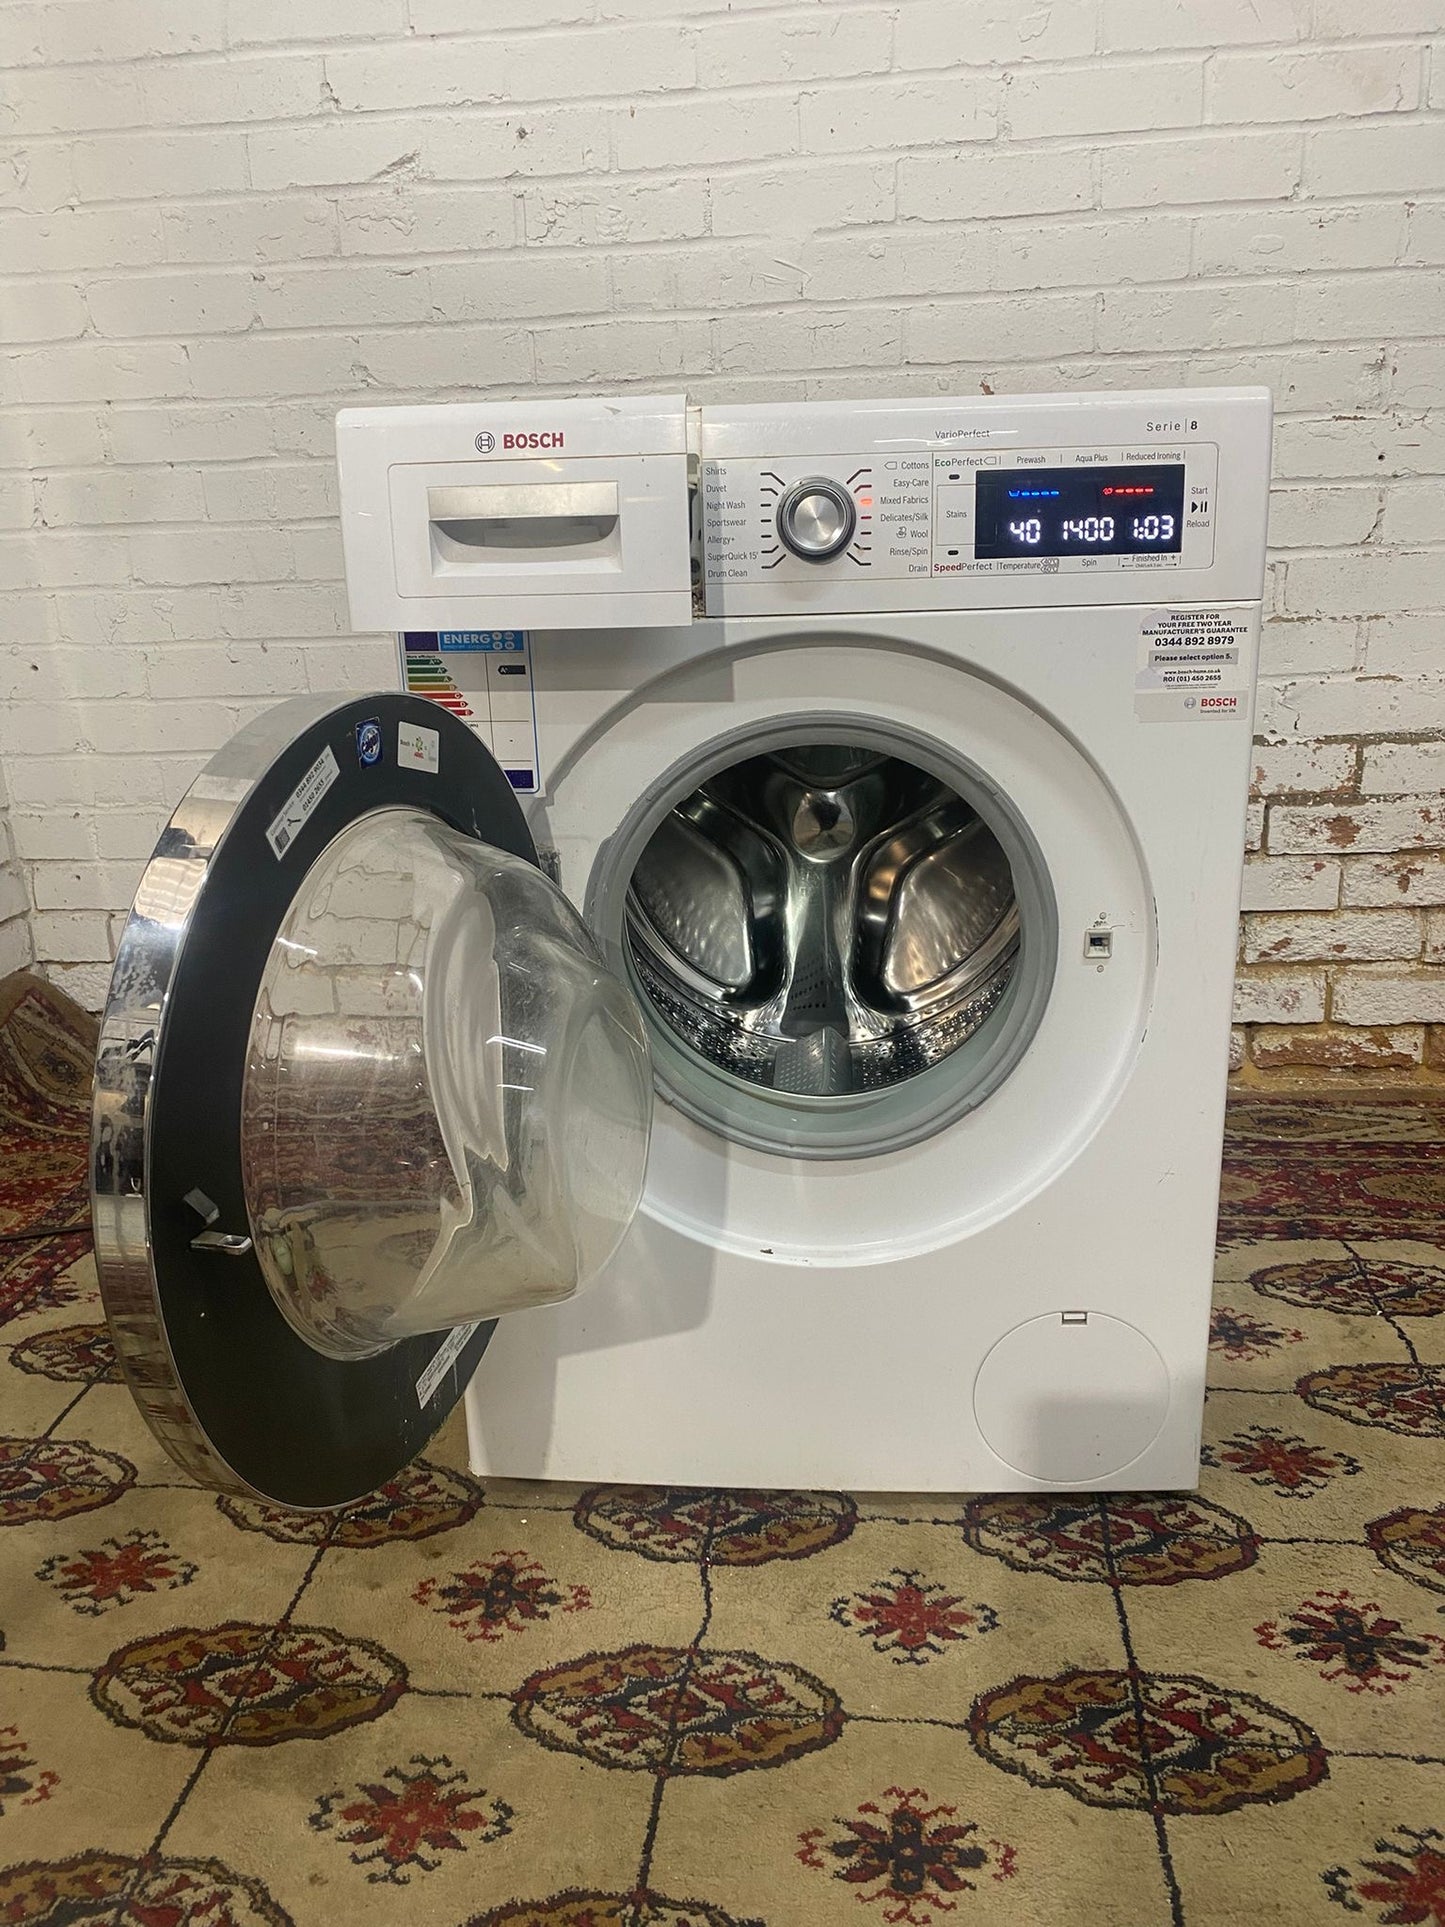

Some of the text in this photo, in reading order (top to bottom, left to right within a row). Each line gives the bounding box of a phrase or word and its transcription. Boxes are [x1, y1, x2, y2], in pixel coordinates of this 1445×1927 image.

[1146, 420, 1198, 432] Serie 8
[935, 429, 991, 440] VarioPerfect
[503, 432, 564, 449] BOSCH
[1016, 455, 1046, 464] Prewash
[1075, 453, 1108, 463] Aqua Plus
[1126, 451, 1181, 461] Reduced Ironing
[901, 461, 929, 470] Cottons
[934, 456, 984, 467] EcoPerfect
[705, 467, 727, 476] Shirts
[706, 484, 727, 493] Duvet
[893, 479, 929, 489] Easy-Care
[1190, 486, 1208, 495] Start
[880, 494, 929, 505] Mixed Fabrics
[706, 501, 746, 511] Night Wash
[880, 513, 929, 522] Delicates/Silk
[946, 511, 967, 519] Stains
[707, 519, 746, 528] Sportswear
[1133, 514, 1175, 540] 1:03
[1186, 520, 1210, 529] Reload
[1009, 518, 1041, 544] 40
[1063, 516, 1116, 542] 1400
[910, 530, 929, 539] Wool
[707, 536, 735, 545] Allergy+
[707, 552, 748, 561] SuperQuick
[889, 547, 929, 557] Rinse/Spin
[933, 562, 993, 573] SpeedPerfect
[1000, 562, 1041, 571] Temperature
[1081, 558, 1097, 567] Spin
[707, 568, 748, 578] Drum Clean
[908, 565, 928, 573] Drain
[1142, 626, 1248, 636] MANUFACTURER'S GUARANTEE
[443, 633, 491, 645] ENERG
[1154, 635, 1235, 647] 0344 892 8979
[1154, 654, 1178, 662] Please
[1179, 653, 1200, 661] select
[1201, 652, 1225, 661] option
[1176, 675, 1191, 683] (01)
[1201, 698, 1237, 707] BOSCH
